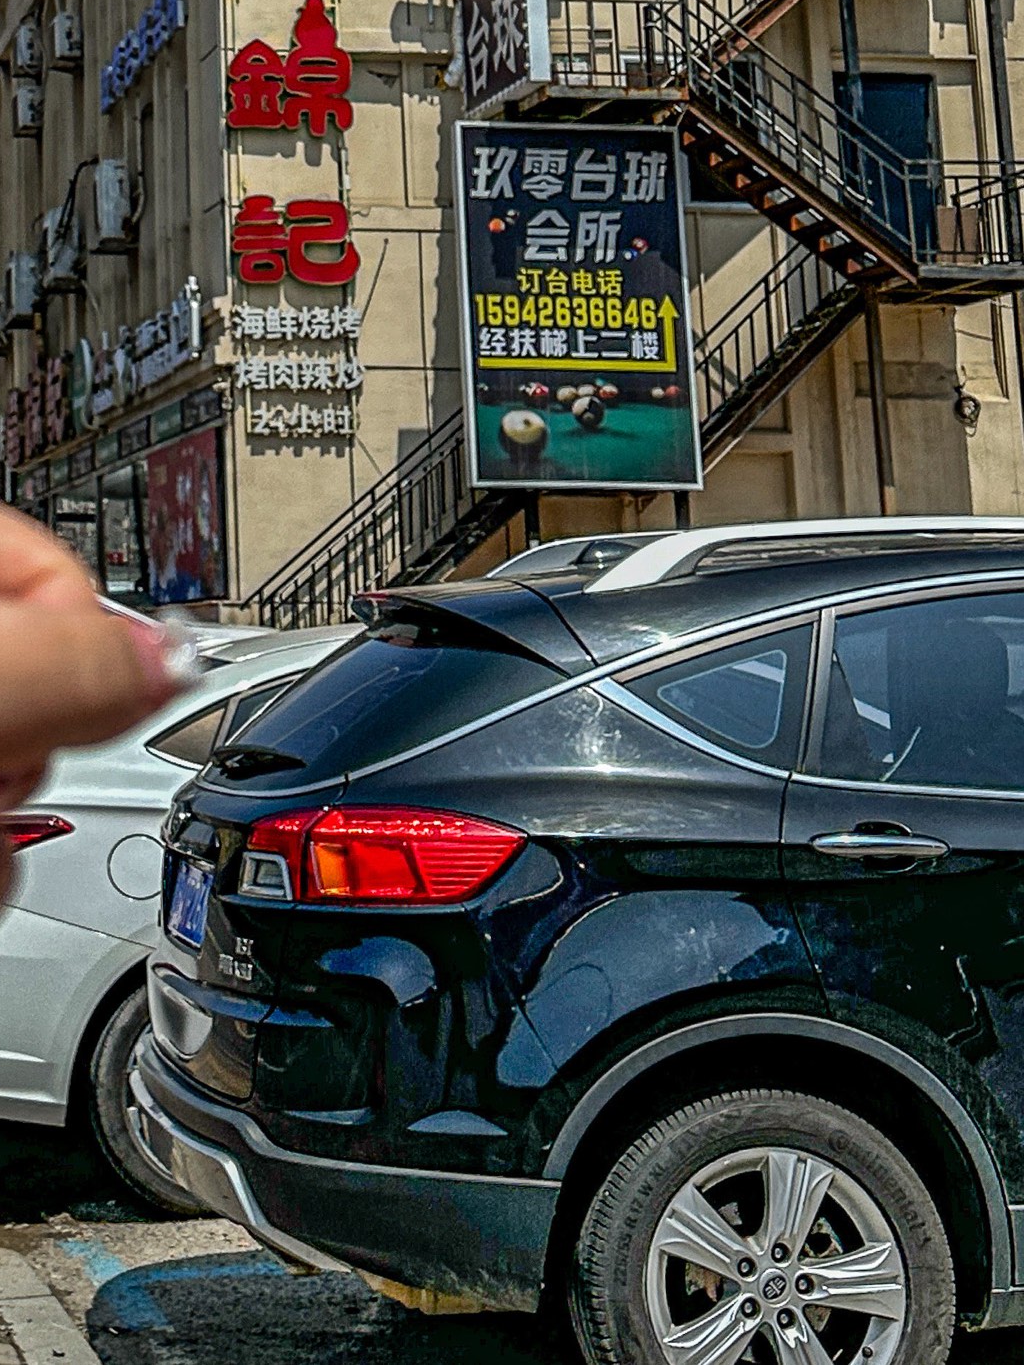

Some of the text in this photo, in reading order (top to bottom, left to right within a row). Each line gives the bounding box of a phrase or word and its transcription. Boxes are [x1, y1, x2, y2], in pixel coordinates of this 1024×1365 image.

[469, 145, 669, 203] 玖零台球
[523, 208, 624, 264] 会所
[516, 267, 624, 297] 订台电话
[231, 302, 363, 340] 海鲜烧烤
[474, 293, 658, 330] 15942636646
[478, 326, 661, 360] 经扶梯上二楼
[233, 355, 366, 390] 烤肉辣炒
[251, 403, 354, 434] 24小时
